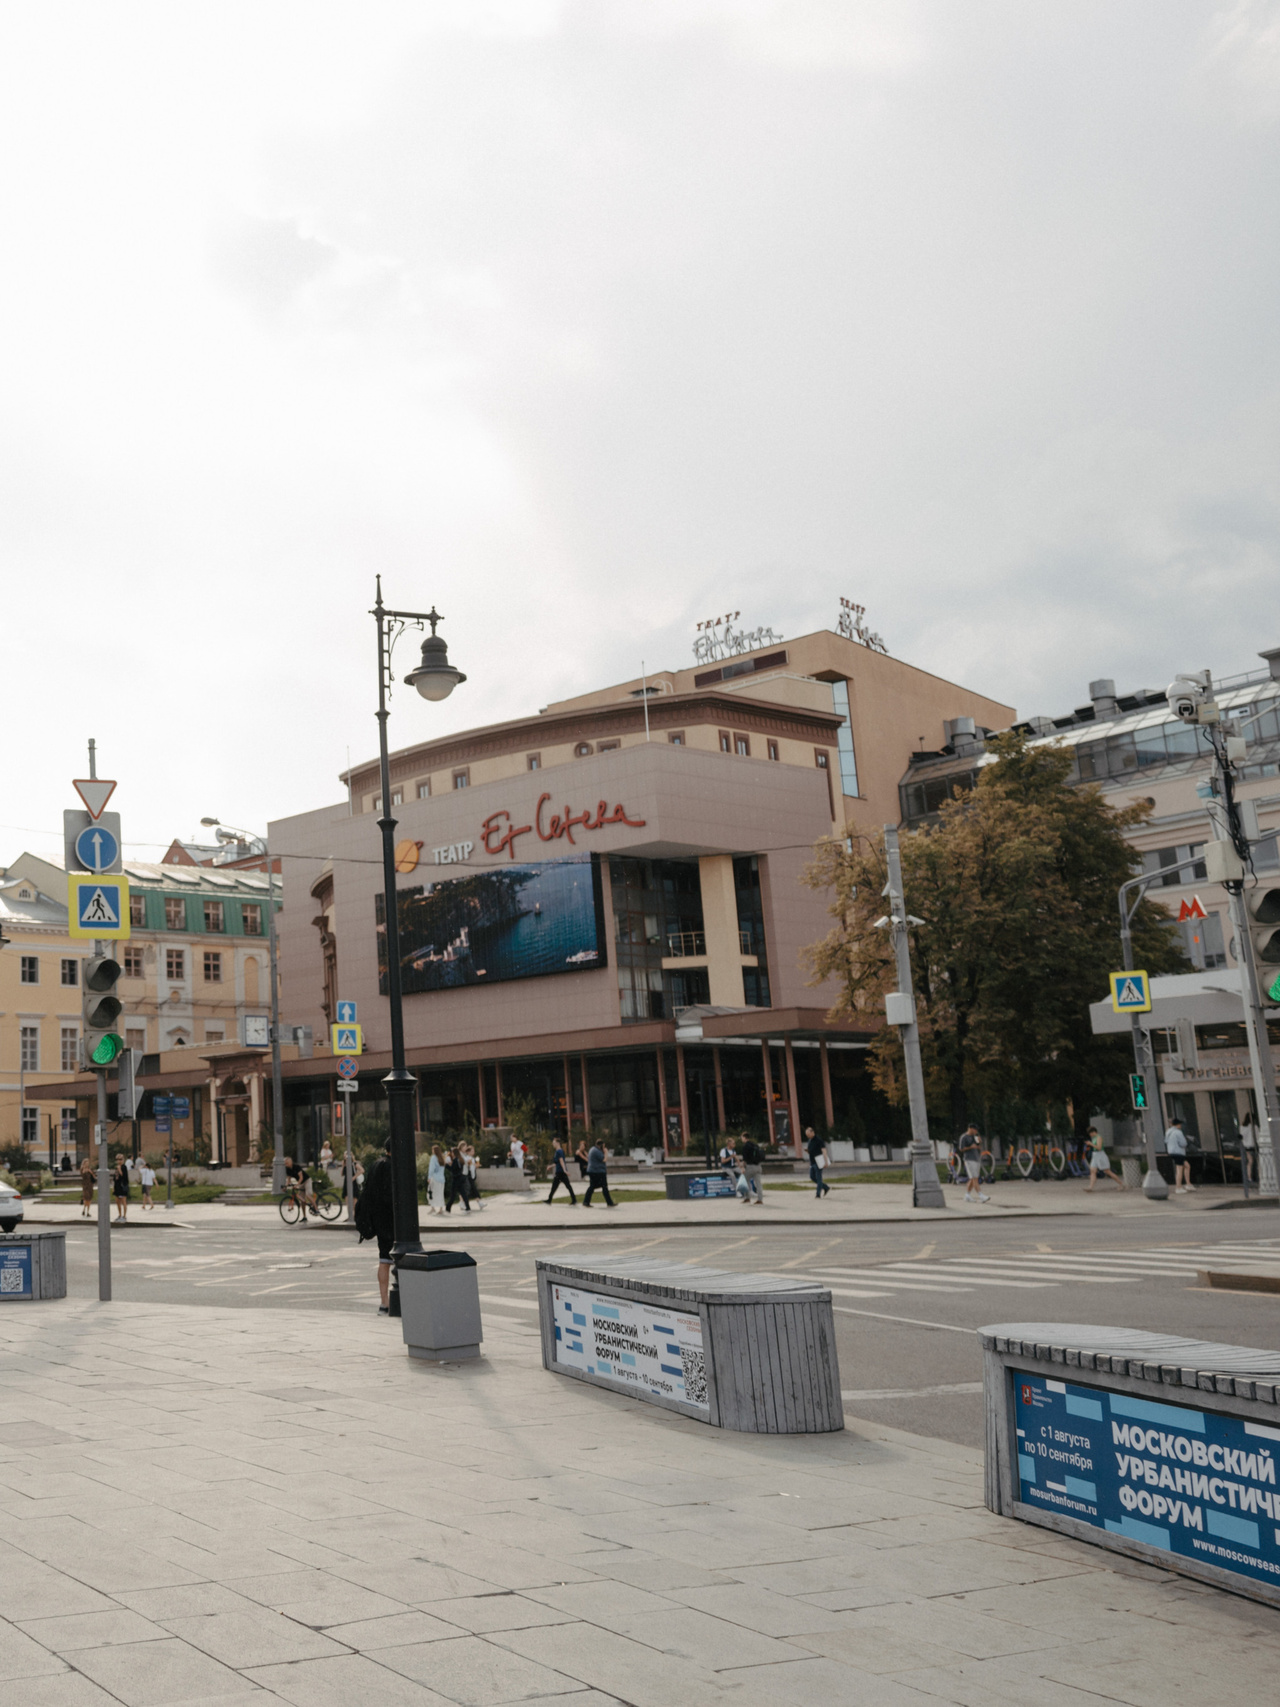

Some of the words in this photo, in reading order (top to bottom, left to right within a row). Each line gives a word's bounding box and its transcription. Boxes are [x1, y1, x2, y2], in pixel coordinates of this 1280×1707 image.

[696, 610, 741, 632] ТЕАТР
[480, 810, 532, 860] Et
[535, 793, 647, 845] Cetera
[432, 841, 474, 866] ТЕАТР
[592, 1317, 639, 1339] МОСКОВСКИЙ
[594, 1331, 659, 1361] УРБАНИСТИЧЕСКИЙ
[595, 1346, 621, 1363] ФОРУМ
[617, 1366, 639, 1381] августа
[642, 1373, 648, 1384] 10
[649, 1377, 674, 1394] сентября
[1040, 1426, 1047, 1438] с
[1047, 1425, 1053, 1439] 1
[1054, 1430, 1091, 1450] августа
[1024, 1441, 1036, 1454] по
[1036, 1442, 1048, 1458] 10
[1048, 1449, 1093, 1471] сентября
[1111, 1420, 1277, 1486] МОСКОВСКИЙ
[1029, 1487, 1098, 1517] mosurbanforum.ru
[1118, 1484, 1204, 1532] ФОРУМ
